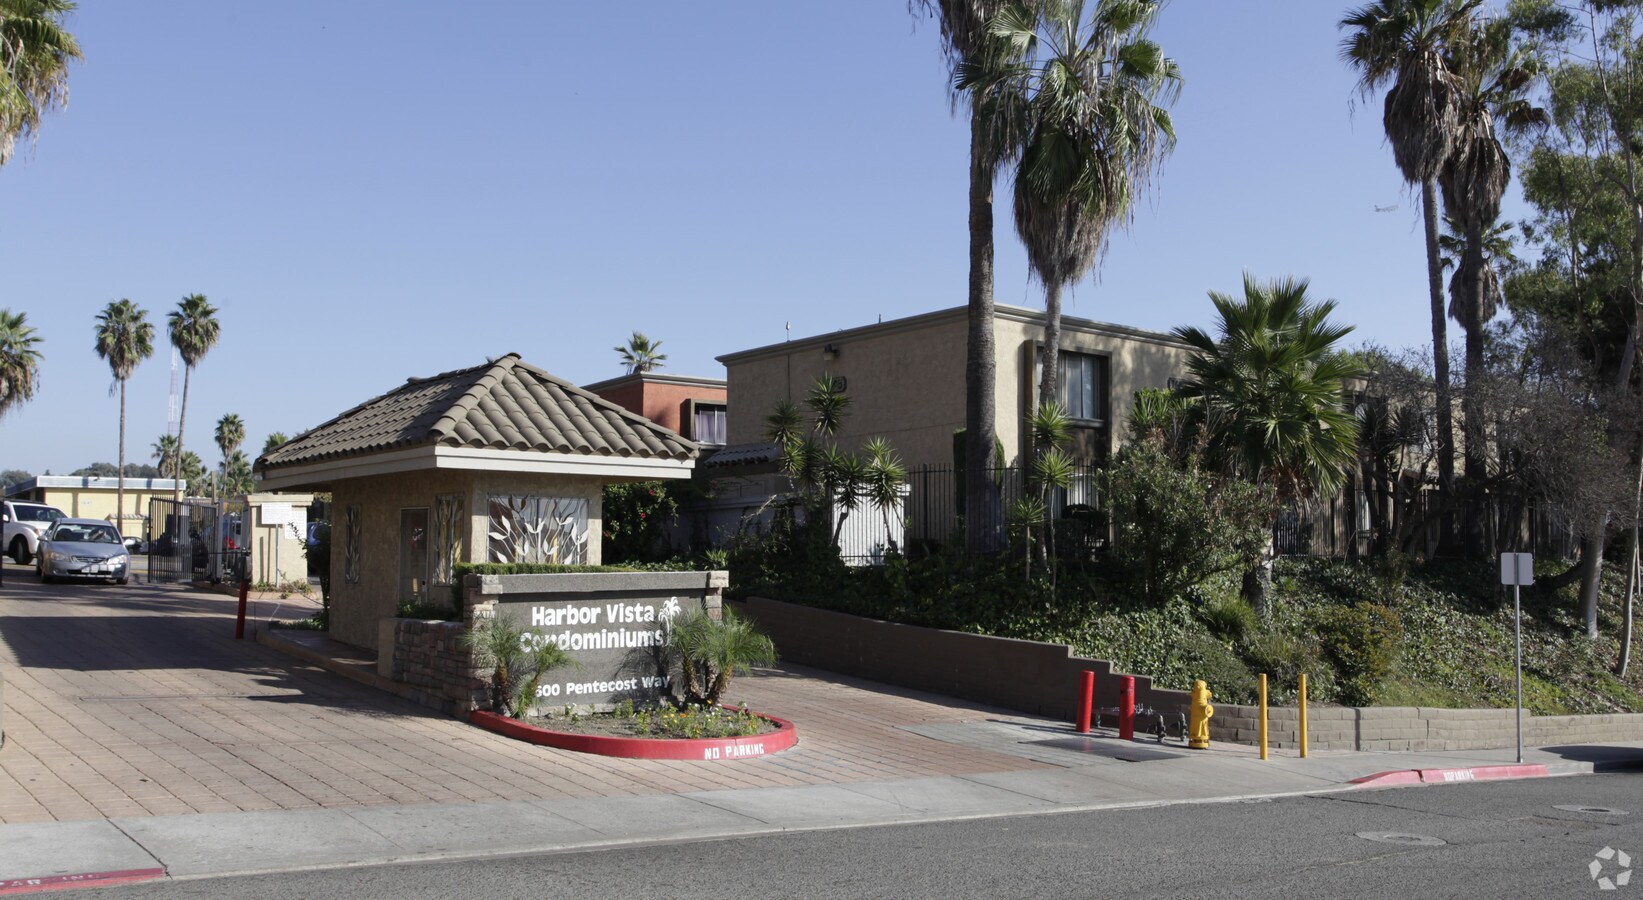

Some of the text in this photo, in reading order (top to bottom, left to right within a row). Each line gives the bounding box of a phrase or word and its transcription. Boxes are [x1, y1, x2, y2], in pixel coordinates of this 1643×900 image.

[531, 602, 655, 626] Harbor Vista
[566, 677, 637, 695] Pentecost
[642, 676, 670, 689] Way
[704, 743, 765, 760] NO PARKING
